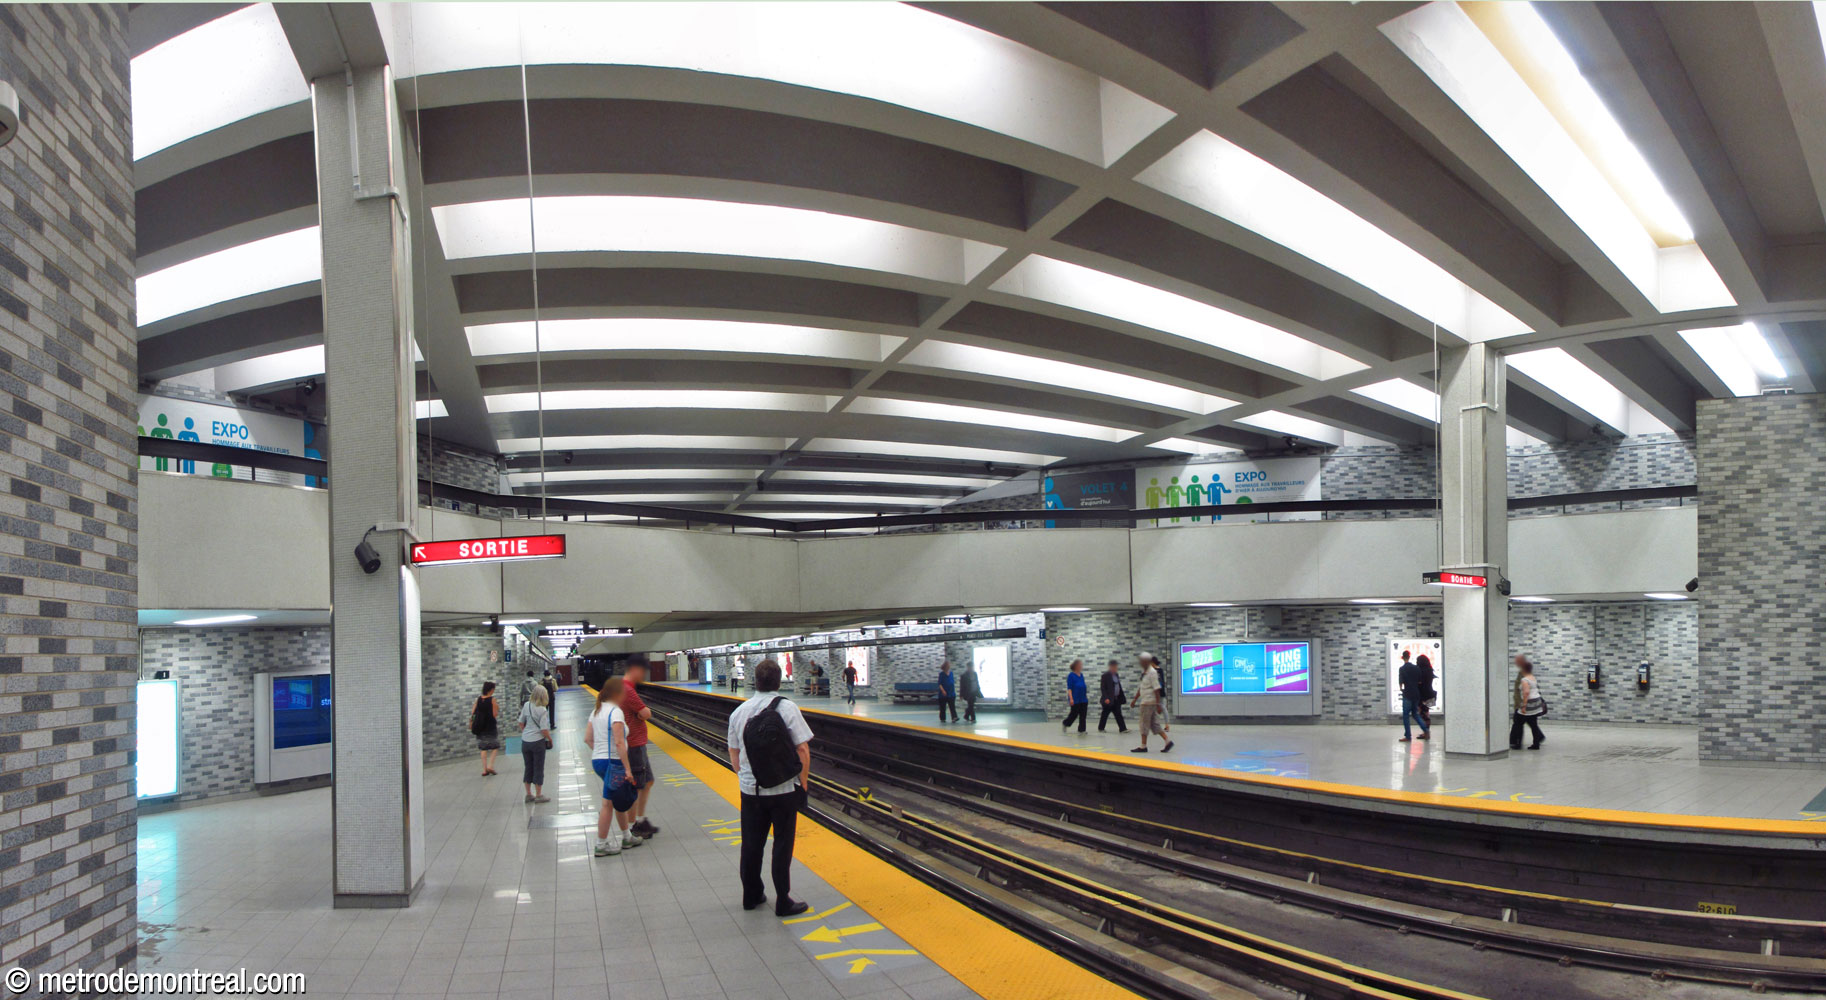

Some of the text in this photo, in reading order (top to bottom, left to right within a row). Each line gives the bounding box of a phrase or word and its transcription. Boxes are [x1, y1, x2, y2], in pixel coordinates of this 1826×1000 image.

[212, 420, 248, 440] EXPO
[212, 438, 240, 448] HOMMAGE
[1235, 471, 1267, 482] EXPO
[1080, 482, 1116, 495] VOLET
[459, 539, 528, 557] SORTIE
[1450, 575, 1473, 584] SORTIE
[1272, 648, 1301, 665] KING
[1272, 660, 1301, 676] KONG
[1192, 672, 1214, 690] JOE
